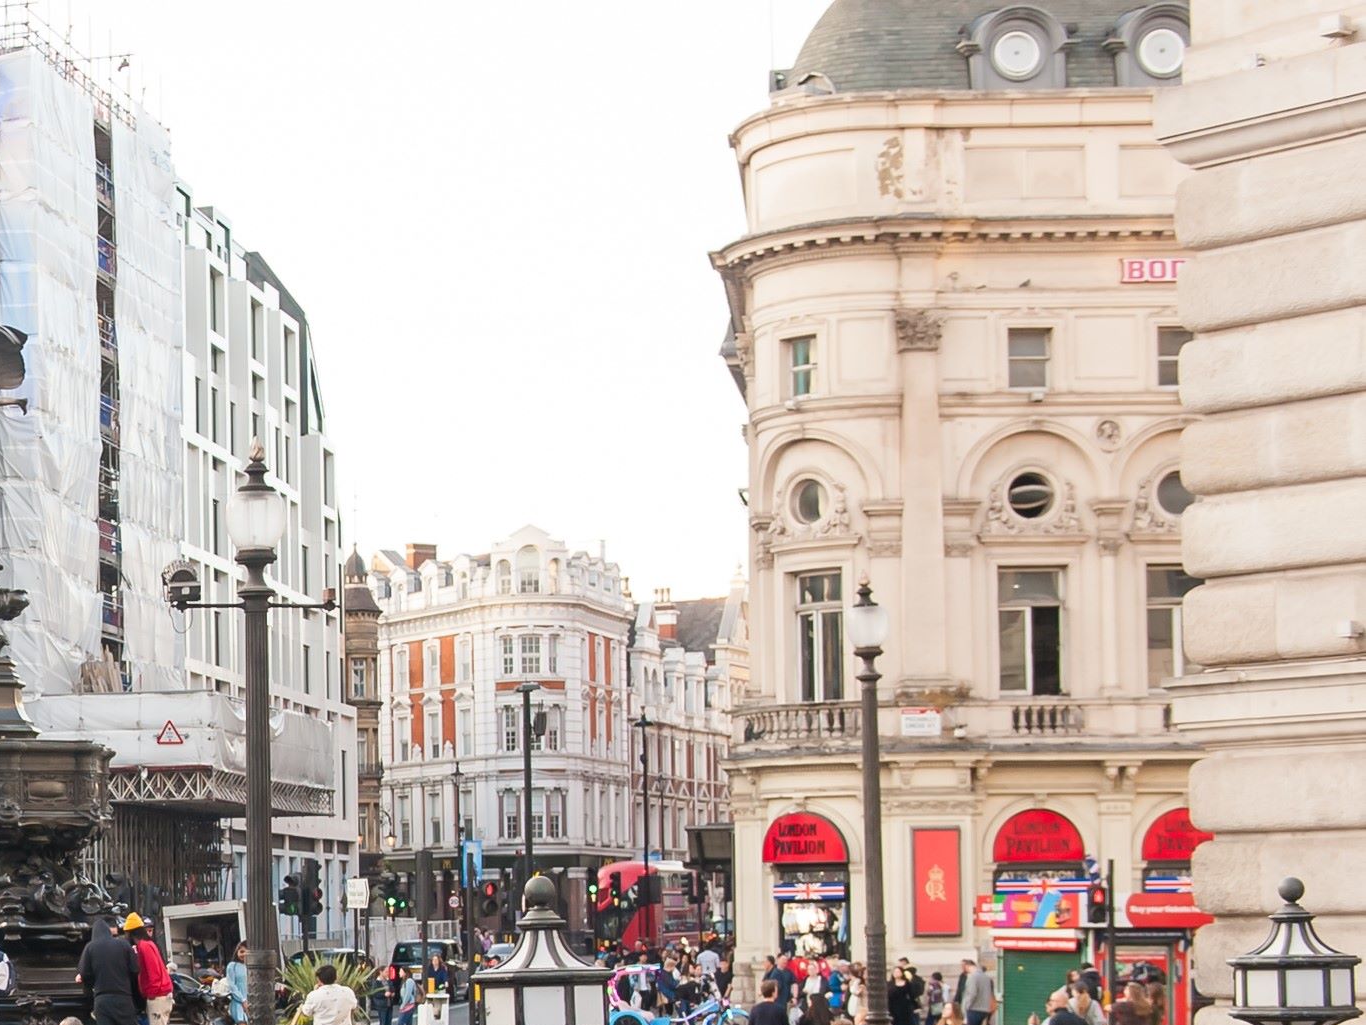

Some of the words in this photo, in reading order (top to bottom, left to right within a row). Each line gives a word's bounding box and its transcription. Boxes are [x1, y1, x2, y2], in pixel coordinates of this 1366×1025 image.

[778, 823, 818, 837] LONDON
[1013, 820, 1061, 835] LONDON
[773, 837, 826, 859] PAVILION
[1005, 836, 1071, 856] PAVILION
